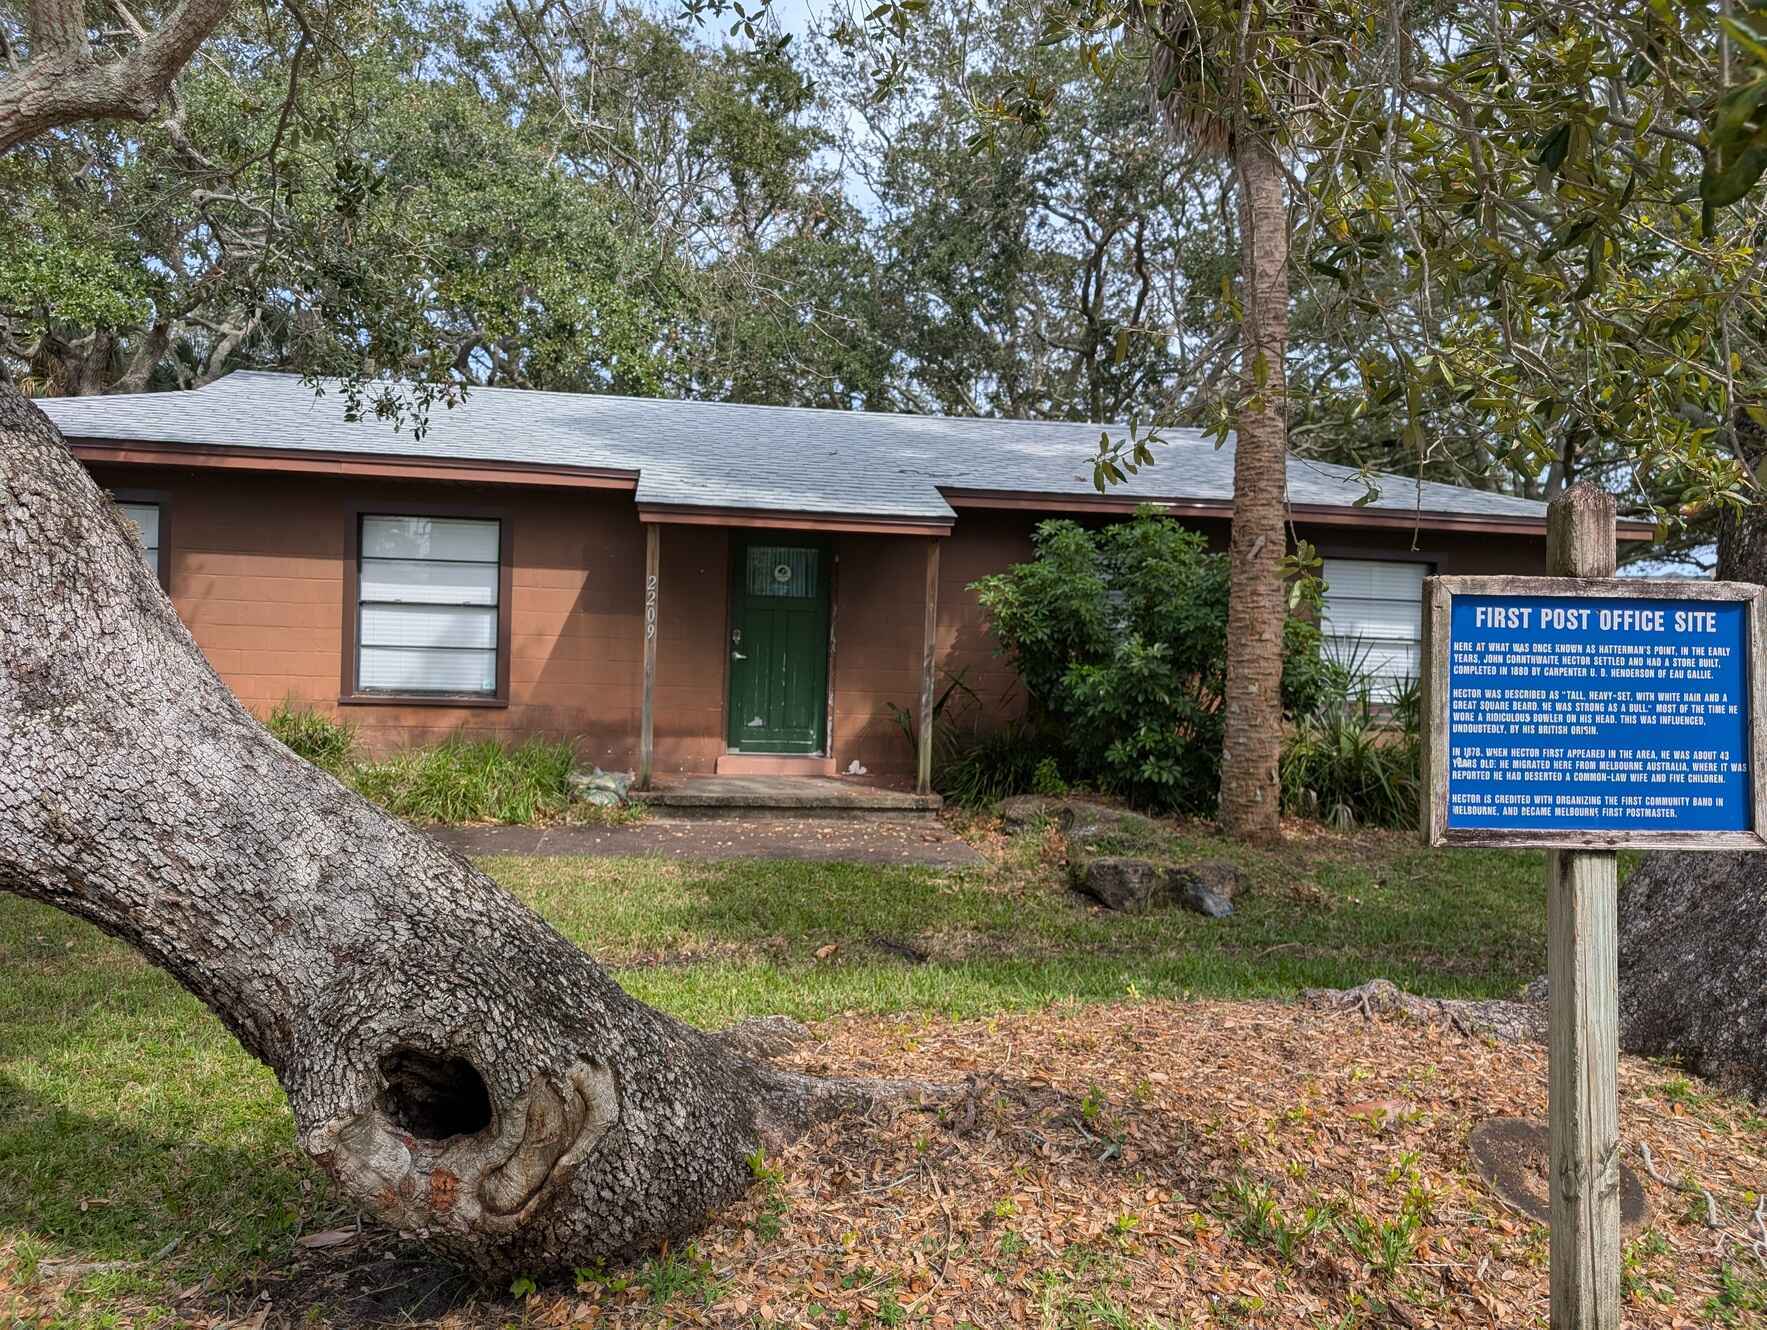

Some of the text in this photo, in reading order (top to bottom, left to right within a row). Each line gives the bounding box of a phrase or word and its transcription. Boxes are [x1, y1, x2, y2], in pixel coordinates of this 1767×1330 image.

[646, 575, 657, 640] 2209
[1476, 607, 1716, 632] FIRST POST OFFICE SITE
[1454, 642, 1731, 656] HERE AT WHAT WAS ONCE KNOWN AS HATTERMAN'S POINT, IN THE EARLY
[1454, 654, 1480, 664] YEARS,
[1484, 655, 1503, 663] JOHN
[1506, 655, 1559, 664] CORNTHWAITE
[1562, 656, 1590, 665] HECTOR
[1594, 657, 1625, 665] SETTLED
[1628, 658, 1643, 666] AND
[1647, 658, 1661, 666] HAD
[1664, 658, 1670, 666] A
[1673, 658, 1696, 667] STORE
[1454, 666, 1496, 674] COMPLETED
[1500, 666, 1508, 675] IN
[1532, 667, 1541, 676] BY
[1544, 668, 1587, 676] CARPENTER
[1611, 669, 1654, 678] HENDERSON
[1658, 670, 1666, 678] OF
[1670, 670, 1684, 679] EAU
[1687, 670, 1714, 679] GALLIE.
[1453, 689, 1481, 698] HECTOR
[1485, 690, 1502, 698] WAS
[1505, 690, 1546, 699] DESCRIBED
[1549, 691, 1559, 699] AS
[1636, 692, 1654, 701] WITH
[1658, 692, 1680, 701] WHITE
[1684, 693, 1701, 702] HAIR
[1704, 693, 1719, 702] AND
[1722, 694, 1728, 702] A
[1453, 701, 1476, 710] GREAT
[1480, 701, 1509, 711] SQUARE
[1542, 702, 1552, 711] HE
[1556, 702, 1572, 711] WAS
[1576, 703, 1604, 712] STRONG
[1608, 704, 1618, 712] AS
[1621, 704, 1626, 712] A
[1656, 704, 1676, 713] MOST
[1680, 704, 1688, 713] OF
[1692, 705, 1704, 714] THE
[1708, 705, 1725, 714] TIME
[1729, 706, 1738, 714] HE
[1453, 712, 1474, 721] WORE
[1478, 713, 1482, 721] A
[1486, 713, 1530, 722] RIDICULOUS
[1534, 714, 1563, 722] BOWLER
[1567, 714, 1576, 723] ON
[1580, 715, 1592, 723] HIS
[1620, 716, 1636, 724] THIS
[1640, 716, 1656, 724] WAS
[1660, 716, 1706, 726] INFLUENCED,
[1510, 725, 1519, 734] BY
[1522, 725, 1535, 734] HIS
[1538, 726, 1568, 734] BRITISH
[1452, 748, 1460, 756] IN
[1486, 748, 1508, 757] WHEN
[1511, 748, 1540, 757] HECTOR
[1543, 749, 1564, 758] FIRST
[1567, 750, 1605, 758] APPEARED
[1608, 750, 1616, 758] IN
[1620, 750, 1632, 758] THE
[1636, 750, 1658, 760] AREA,
[1661, 751, 1670, 759] HE
[1674, 751, 1690, 760] WAS
[1694, 751, 1716, 760] ABOUT
[1500, 760, 1509, 768] HE
[1513, 760, 1550, 769] MIGRATED
[1554, 761, 1572, 770] HERE
[1576, 761, 1596, 770] FROM
[1600, 762, 1643, 770] MELBOURNE
[1693, 763, 1718, 772] WHERE
[1721, 764, 1728, 772] IT
[1731, 764, 1747, 772] WAS
[1452, 771, 1726, 783] REPORTED HE HAD DESERTED A COMMON-LAW WIFE AND FIVE CHILDREN.
[1452, 794, 1723, 806] HECTOR IS CREDITED WITH ORGANIZING THE FIRST COMMUNITY BAND IN
[1503, 806, 1518, 816] AND
[1522, 807, 1551, 816] BECAME
[1555, 808, 1600, 816] MELBOURNE
[1602, 808, 1623, 816] FIRST
